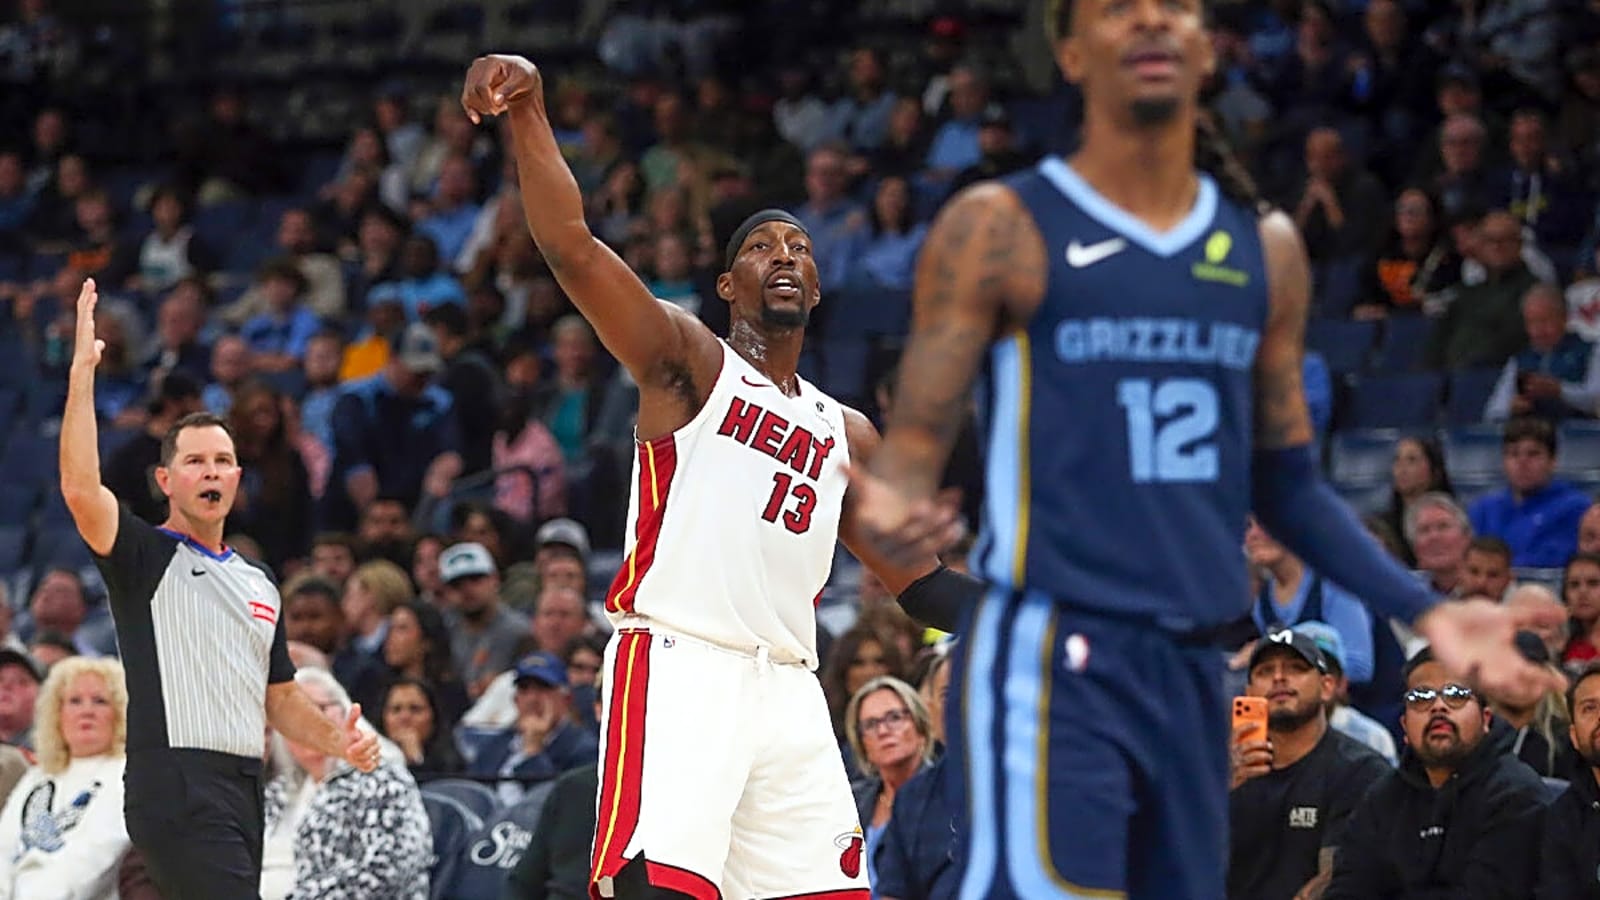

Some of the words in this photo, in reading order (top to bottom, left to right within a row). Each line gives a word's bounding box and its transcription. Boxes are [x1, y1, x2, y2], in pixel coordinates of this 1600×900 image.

[717, 395, 835, 482] HEAT
[1117, 378, 1219, 483] 12
[761, 471, 817, 535] 13
